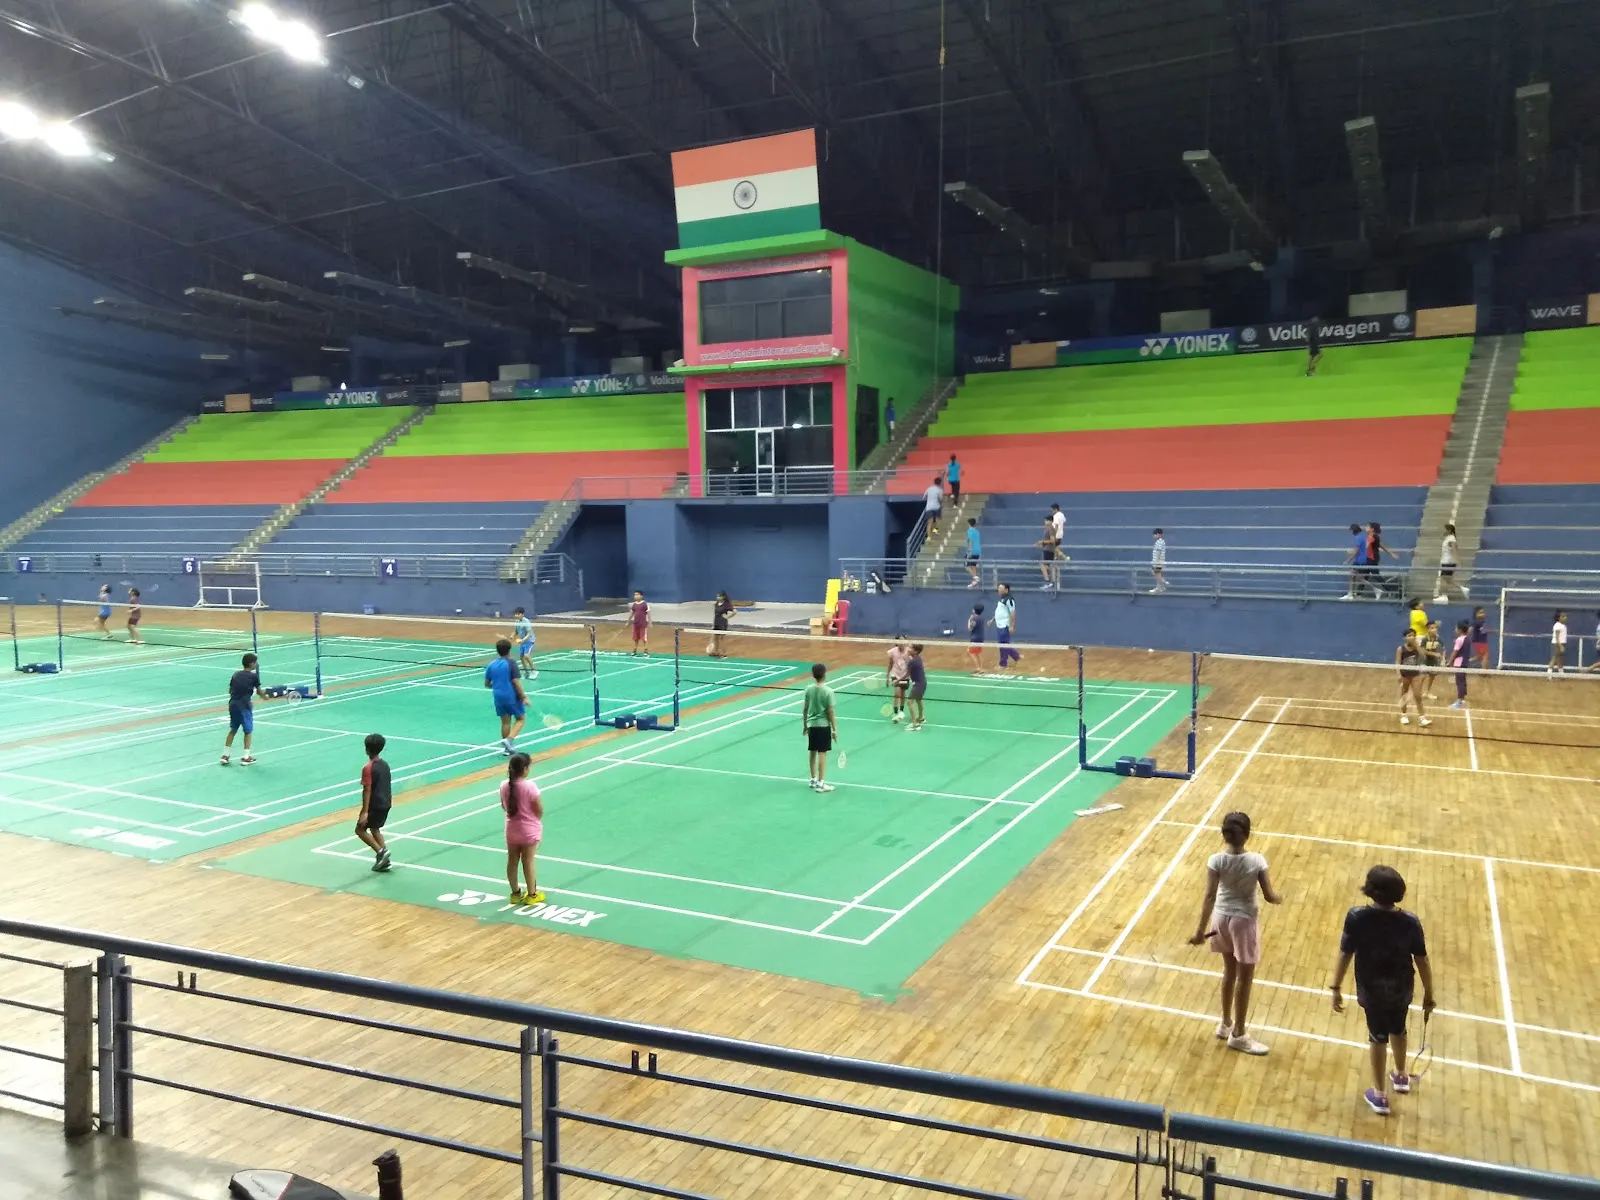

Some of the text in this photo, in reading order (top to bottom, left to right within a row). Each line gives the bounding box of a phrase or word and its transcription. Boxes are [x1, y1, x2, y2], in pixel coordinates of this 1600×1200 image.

[1530, 305, 1581, 319] WAVE
[1268, 321, 1380, 341] Volkwagen
[1174, 333, 1230, 354] YONEX
[650, 374, 686, 386] Volksw
[345, 391, 378, 405] YONEX
[20, 561, 29, 571] 7
[185, 561, 193, 573] 6
[386, 563, 394, 575] 4
